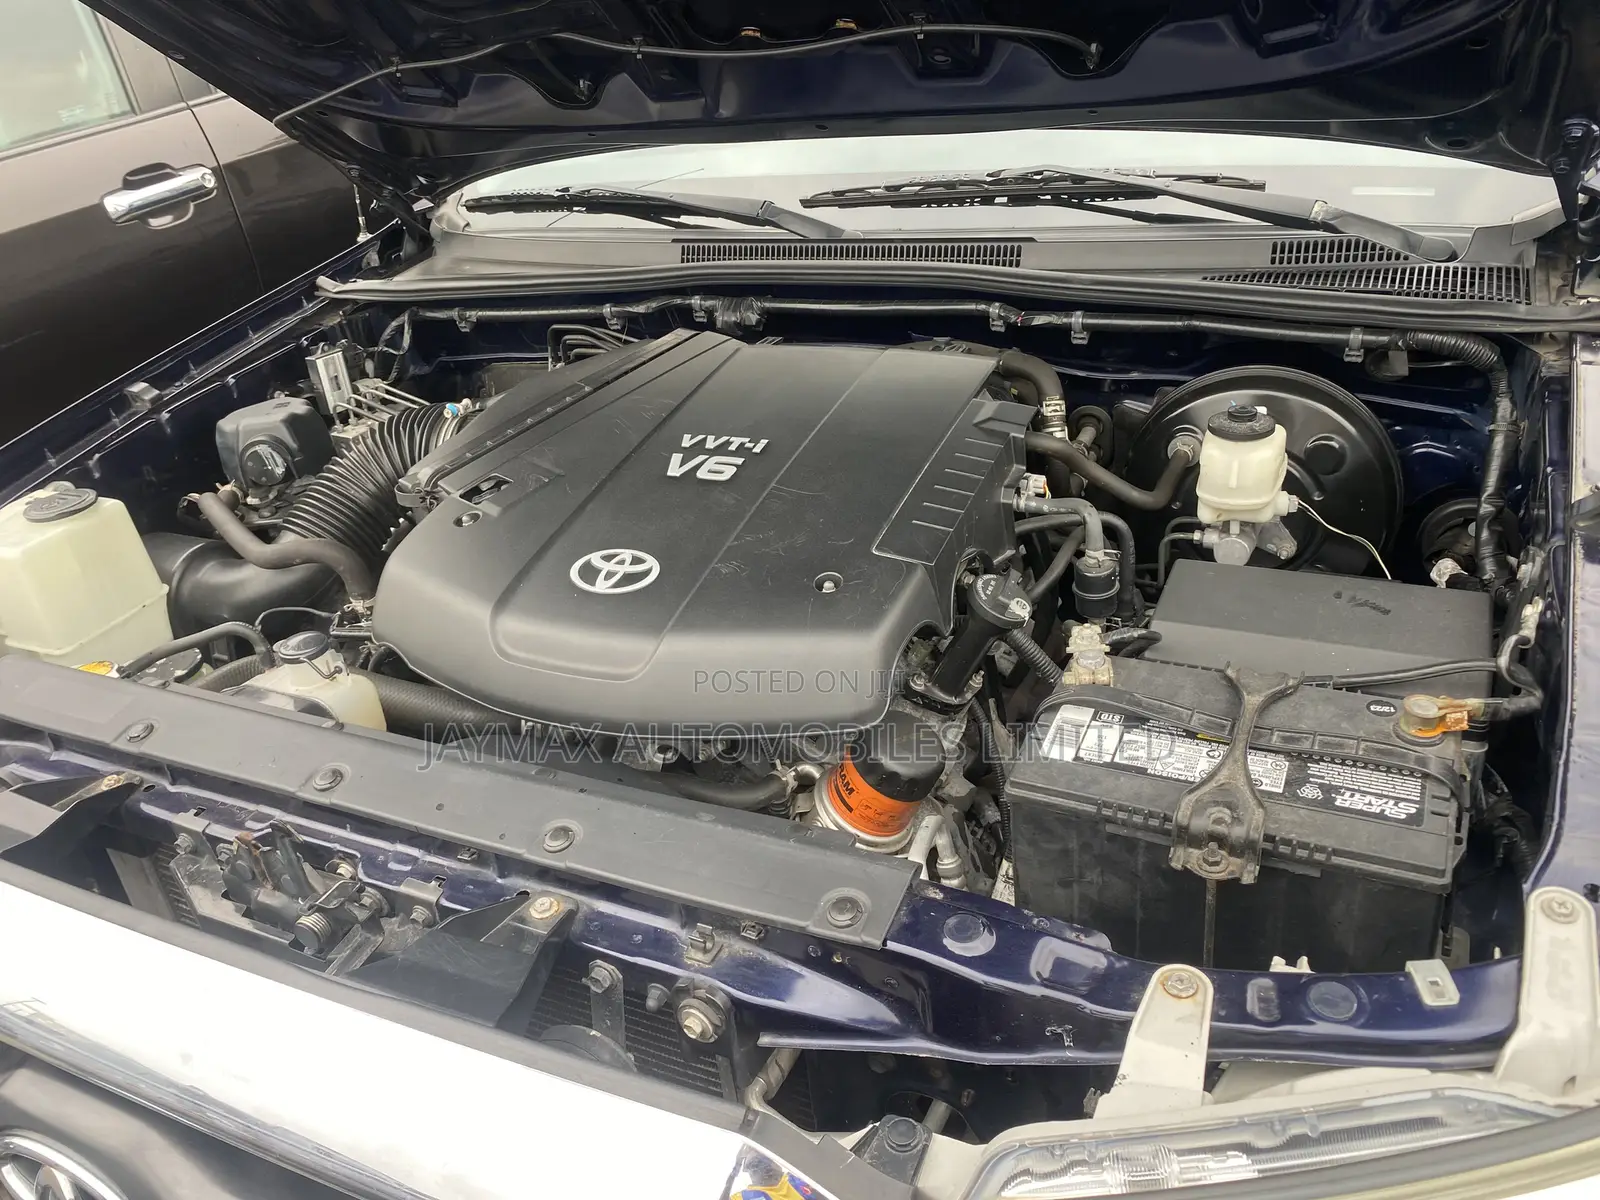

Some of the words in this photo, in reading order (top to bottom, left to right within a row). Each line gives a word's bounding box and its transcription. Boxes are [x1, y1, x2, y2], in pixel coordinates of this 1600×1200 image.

[667, 453, 745, 481] V6
[1101, 713, 1121, 722] STD
[1370, 704, 1396, 713] 12/23
[839, 761, 856, 797] RAM
[1334, 797, 1407, 819] SUPER
[1335, 789, 1420, 814] START
